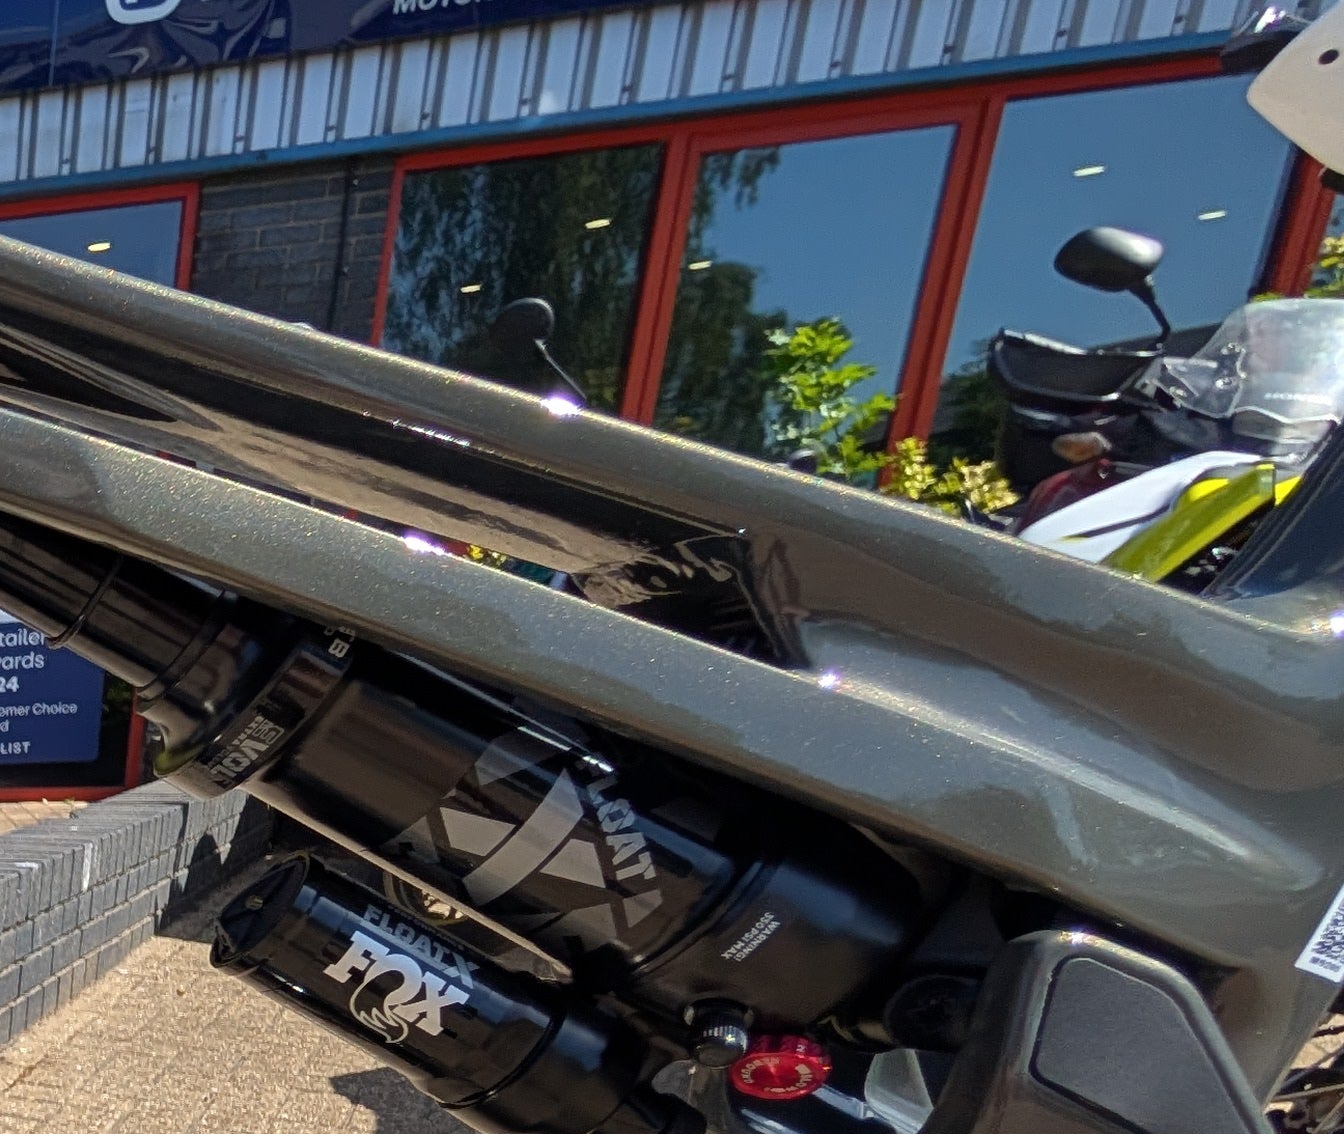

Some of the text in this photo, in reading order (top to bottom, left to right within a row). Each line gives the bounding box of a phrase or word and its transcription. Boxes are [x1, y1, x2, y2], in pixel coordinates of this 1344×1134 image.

[32, 702, 79, 716] Choice
[721, 939, 745, 960] MAX
[323, 930, 471, 1042] FOX
